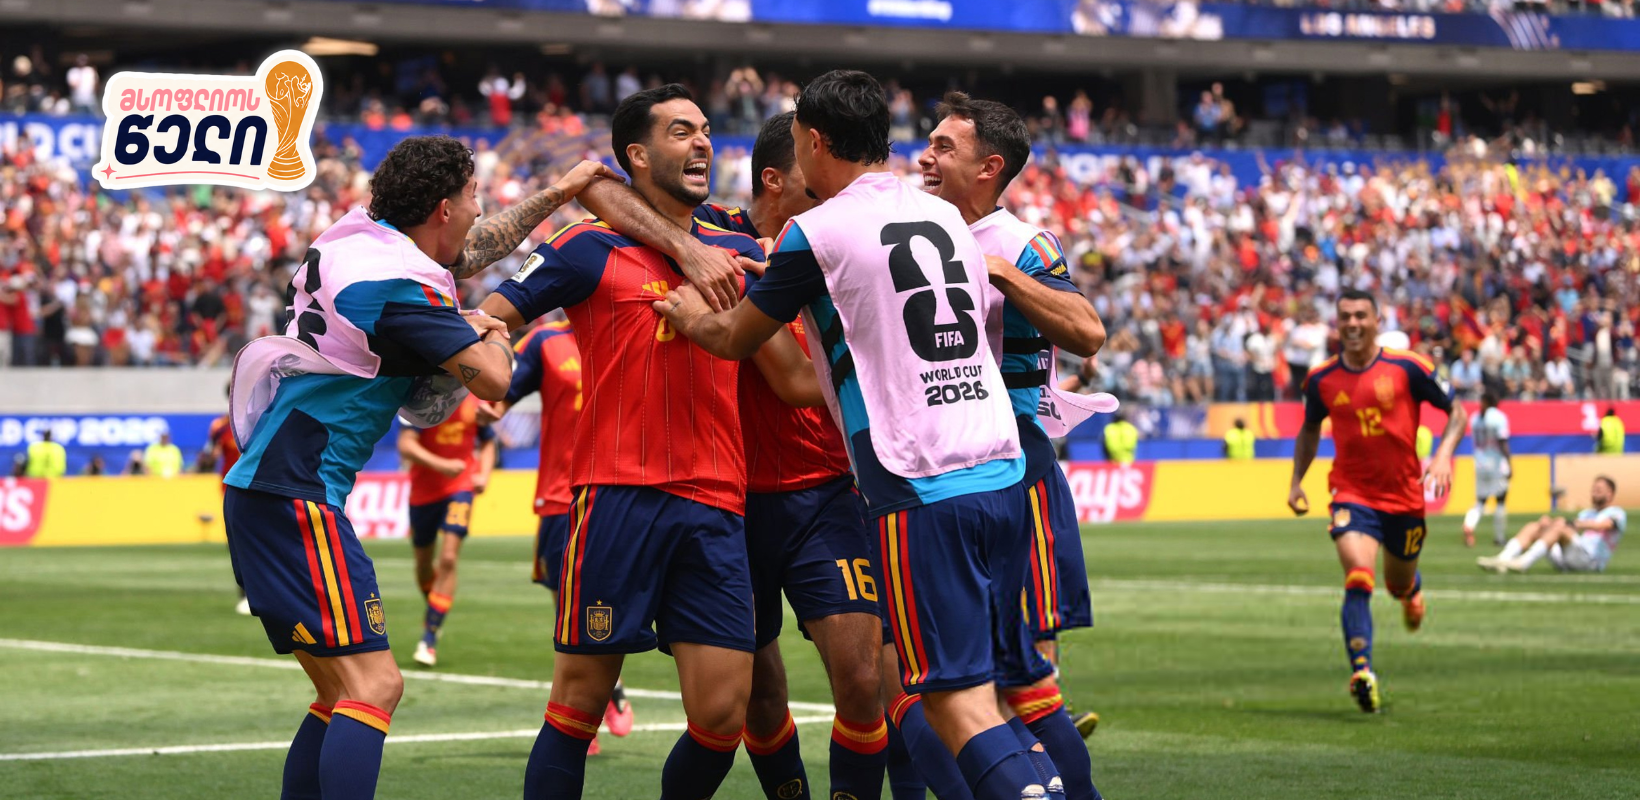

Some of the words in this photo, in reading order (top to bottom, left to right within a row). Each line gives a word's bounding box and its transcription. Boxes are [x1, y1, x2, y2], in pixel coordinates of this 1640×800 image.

[934, 330, 965, 348] FIFA
[919, 366, 962, 384] WORLD
[924, 380, 989, 407] 2026
[1356, 407, 1386, 437] 12
[1404, 526, 1423, 556] 12
[835, 557, 878, 602] 16
